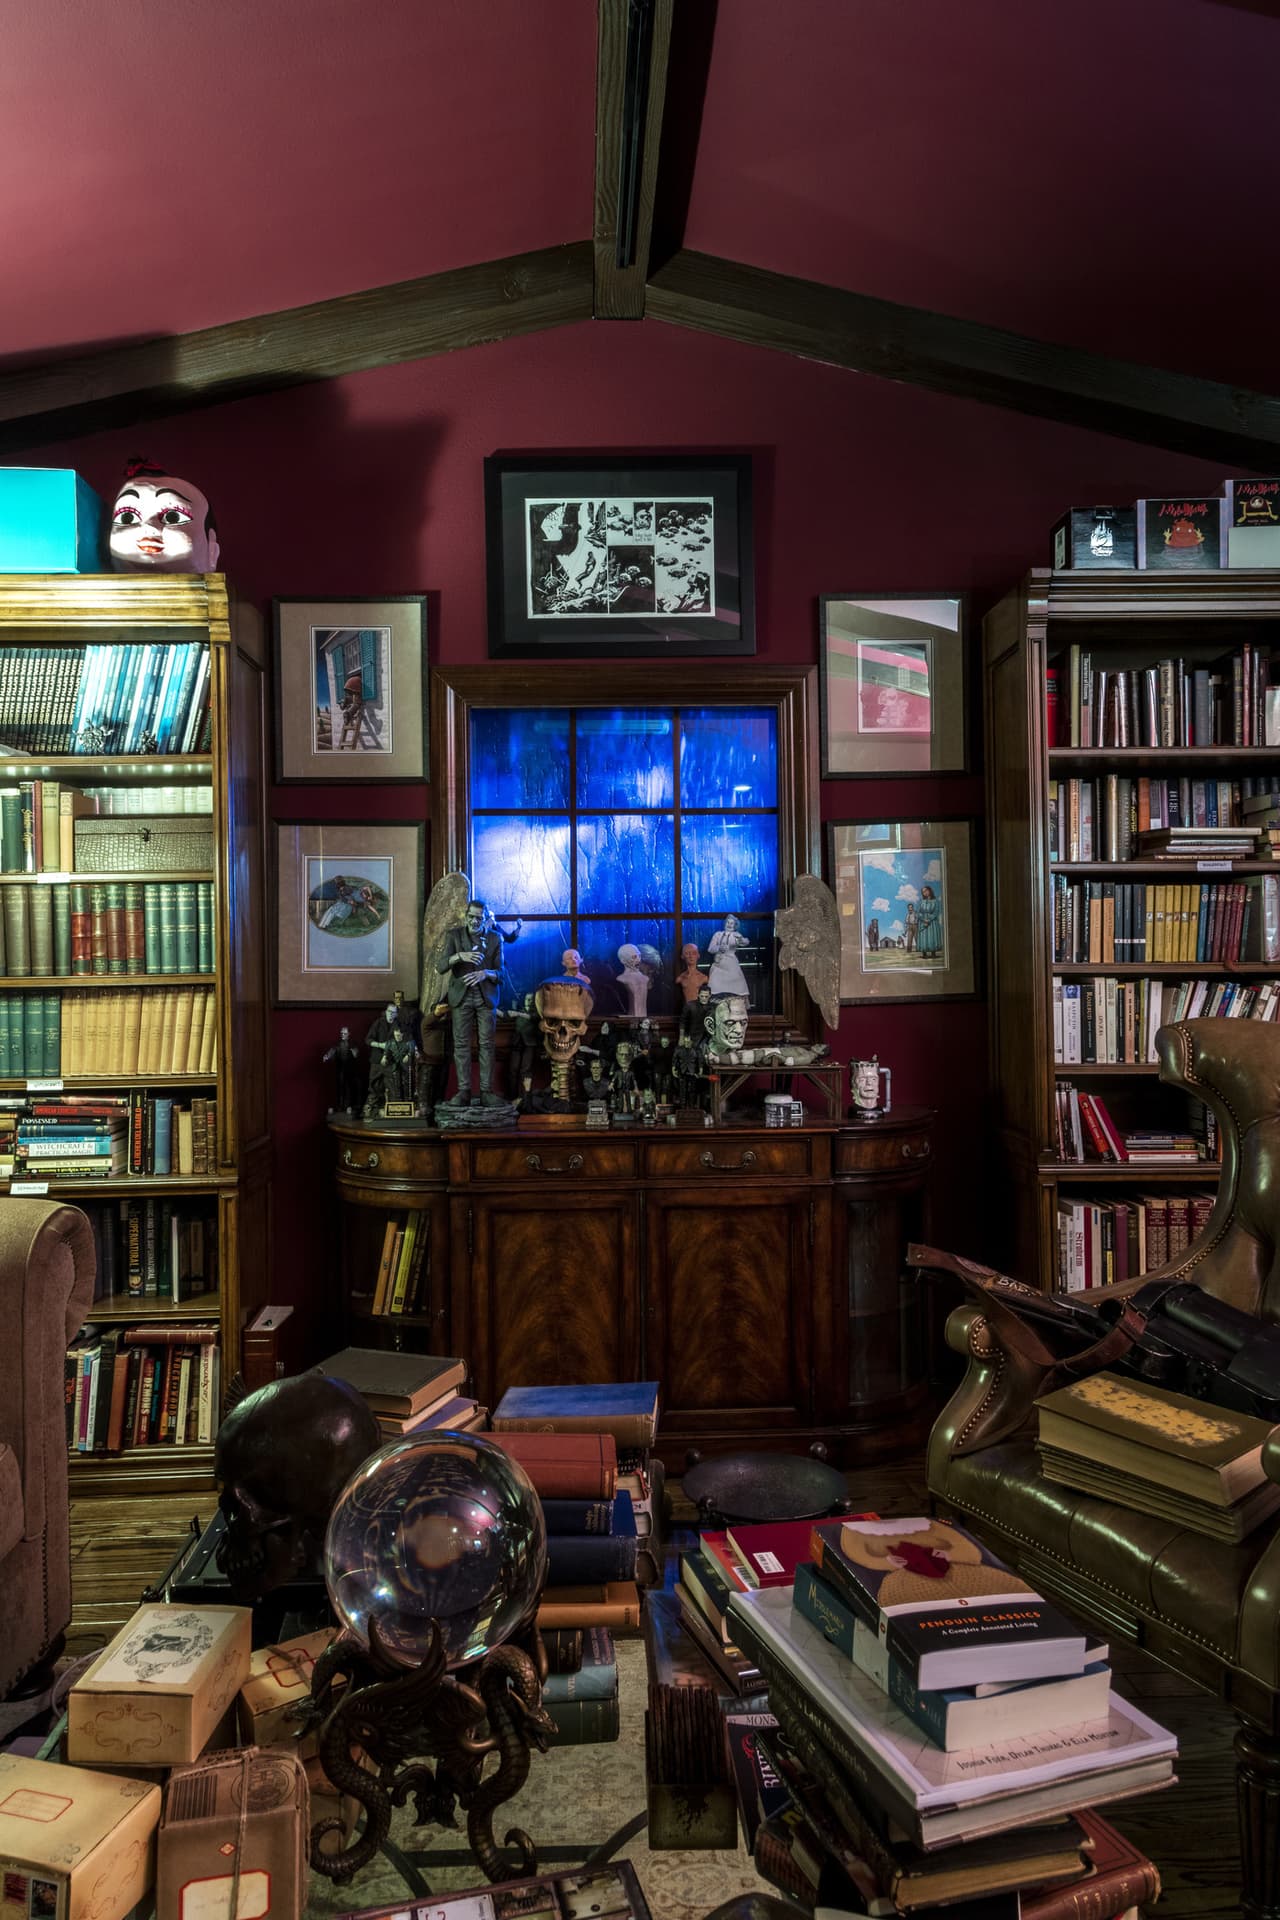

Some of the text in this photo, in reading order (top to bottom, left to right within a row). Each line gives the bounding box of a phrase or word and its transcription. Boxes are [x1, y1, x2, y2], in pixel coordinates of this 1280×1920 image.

[129, 1217, 140, 1267] SUPERNATURAL
[140, 1377, 153, 1415] DEMONS
[918, 1610, 1041, 1630] PENGUIN CLASSICS
[948, 1625, 979, 1636] Complete
[980, 1623, 1011, 1632] Annotated
[1012, 1620, 1039, 1631] Listing
